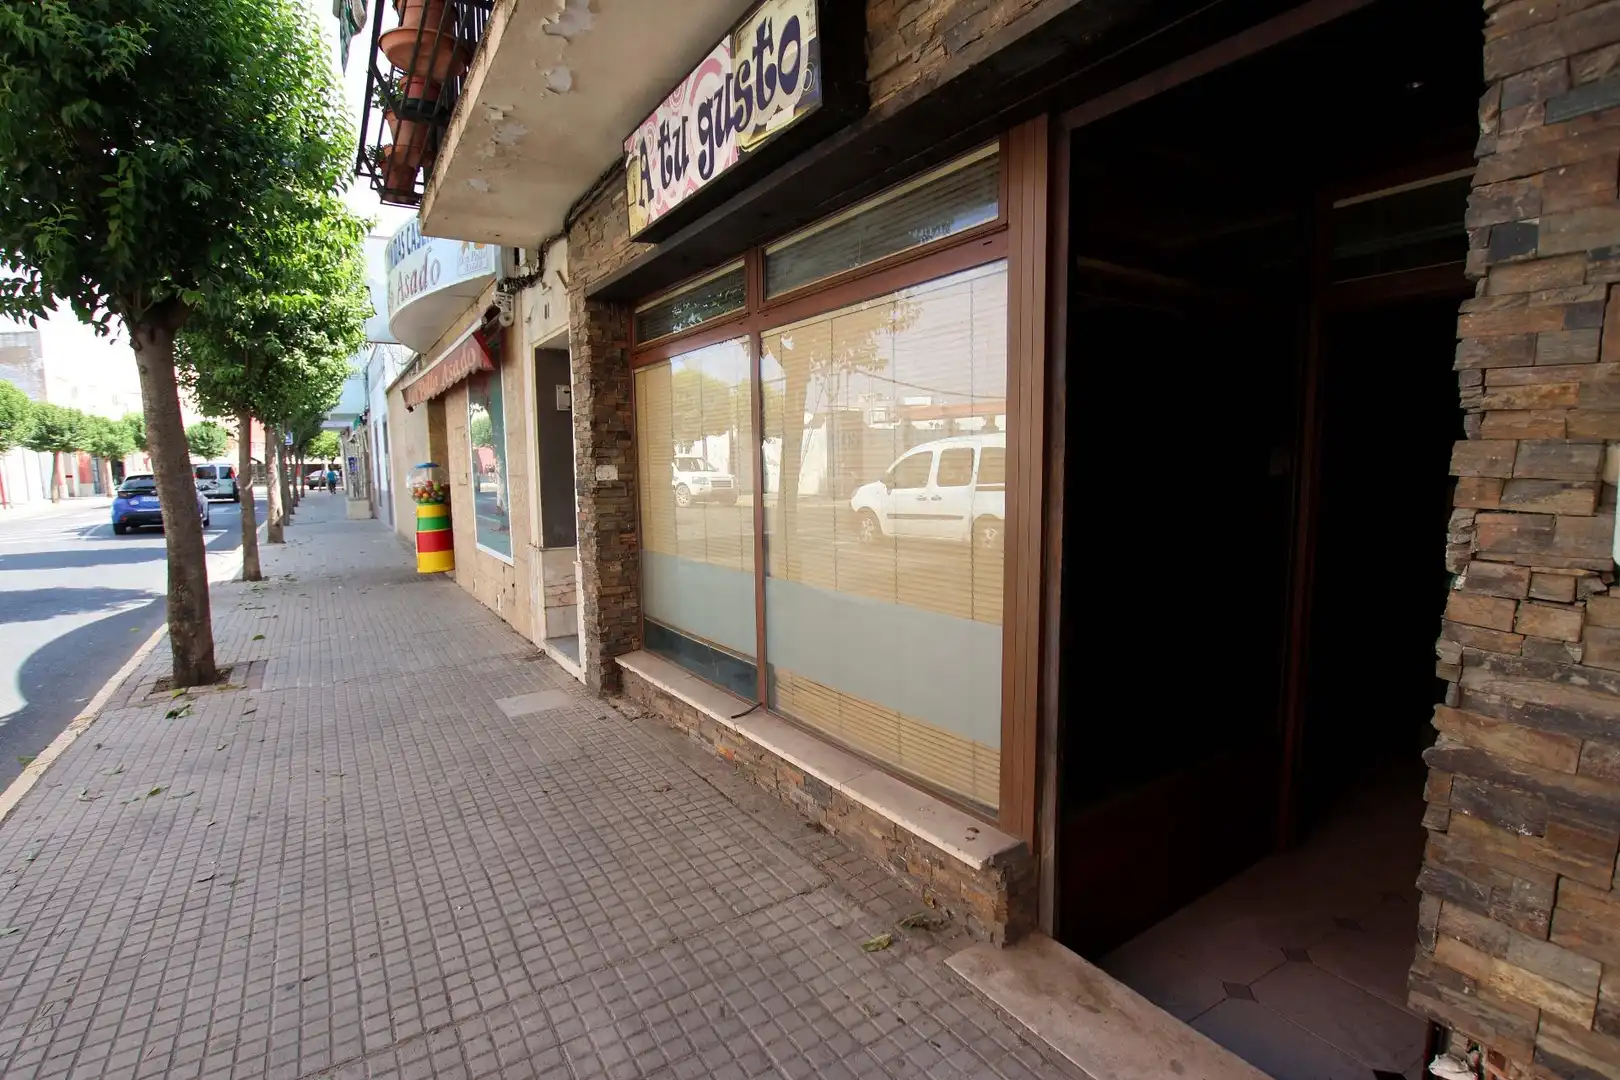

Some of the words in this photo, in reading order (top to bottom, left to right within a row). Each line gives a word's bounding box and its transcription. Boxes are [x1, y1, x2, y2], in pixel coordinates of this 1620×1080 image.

[638, 135, 655, 207] A
[657, 114, 690, 191] tu
[697, 14, 800, 181] gusto
[397, 246, 441, 305] Asado
